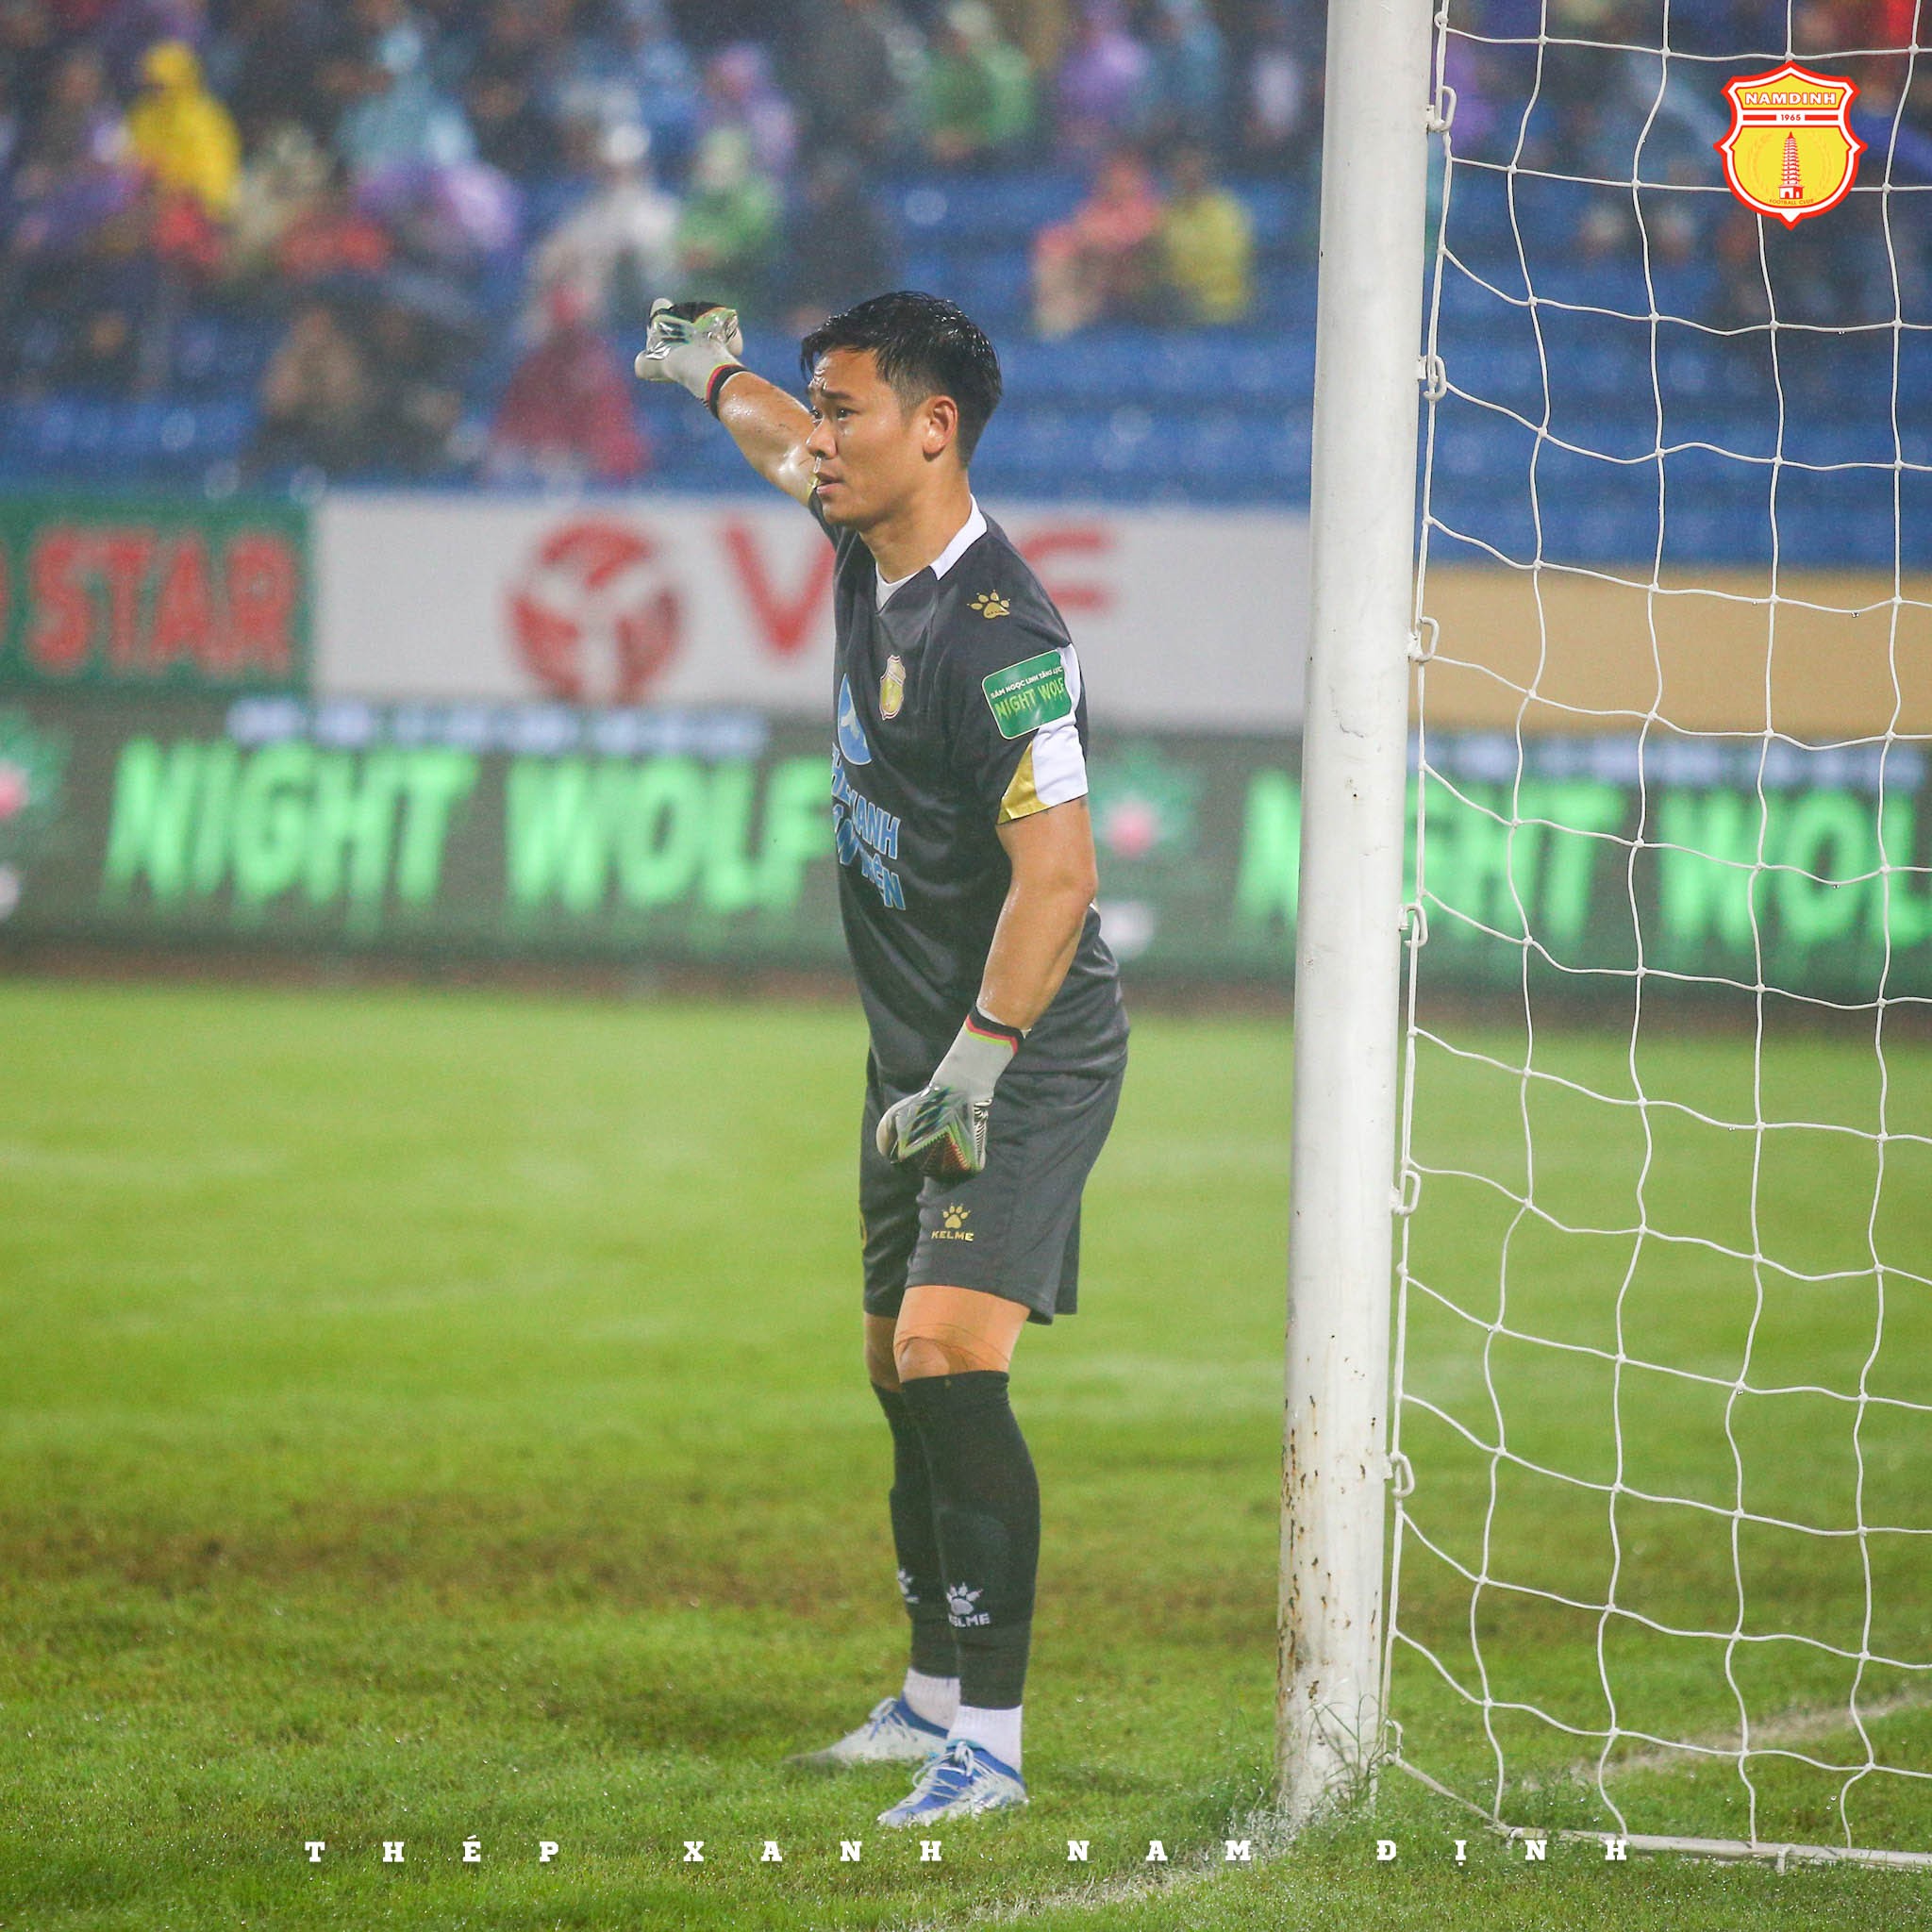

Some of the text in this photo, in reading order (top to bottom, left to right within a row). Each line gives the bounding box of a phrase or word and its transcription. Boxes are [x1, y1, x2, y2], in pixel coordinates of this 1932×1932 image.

[28, 521, 297, 677] STAR
[994, 677, 1065, 718] NIGHT WOLF
[99, 734, 481, 924] NIGHT
[503, 752, 836, 924] WOLF
[1234, 766, 1932, 951] NGHT WOL
[930, 1230, 974, 1242] KELME
[948, 1612, 991, 1628] ELME
